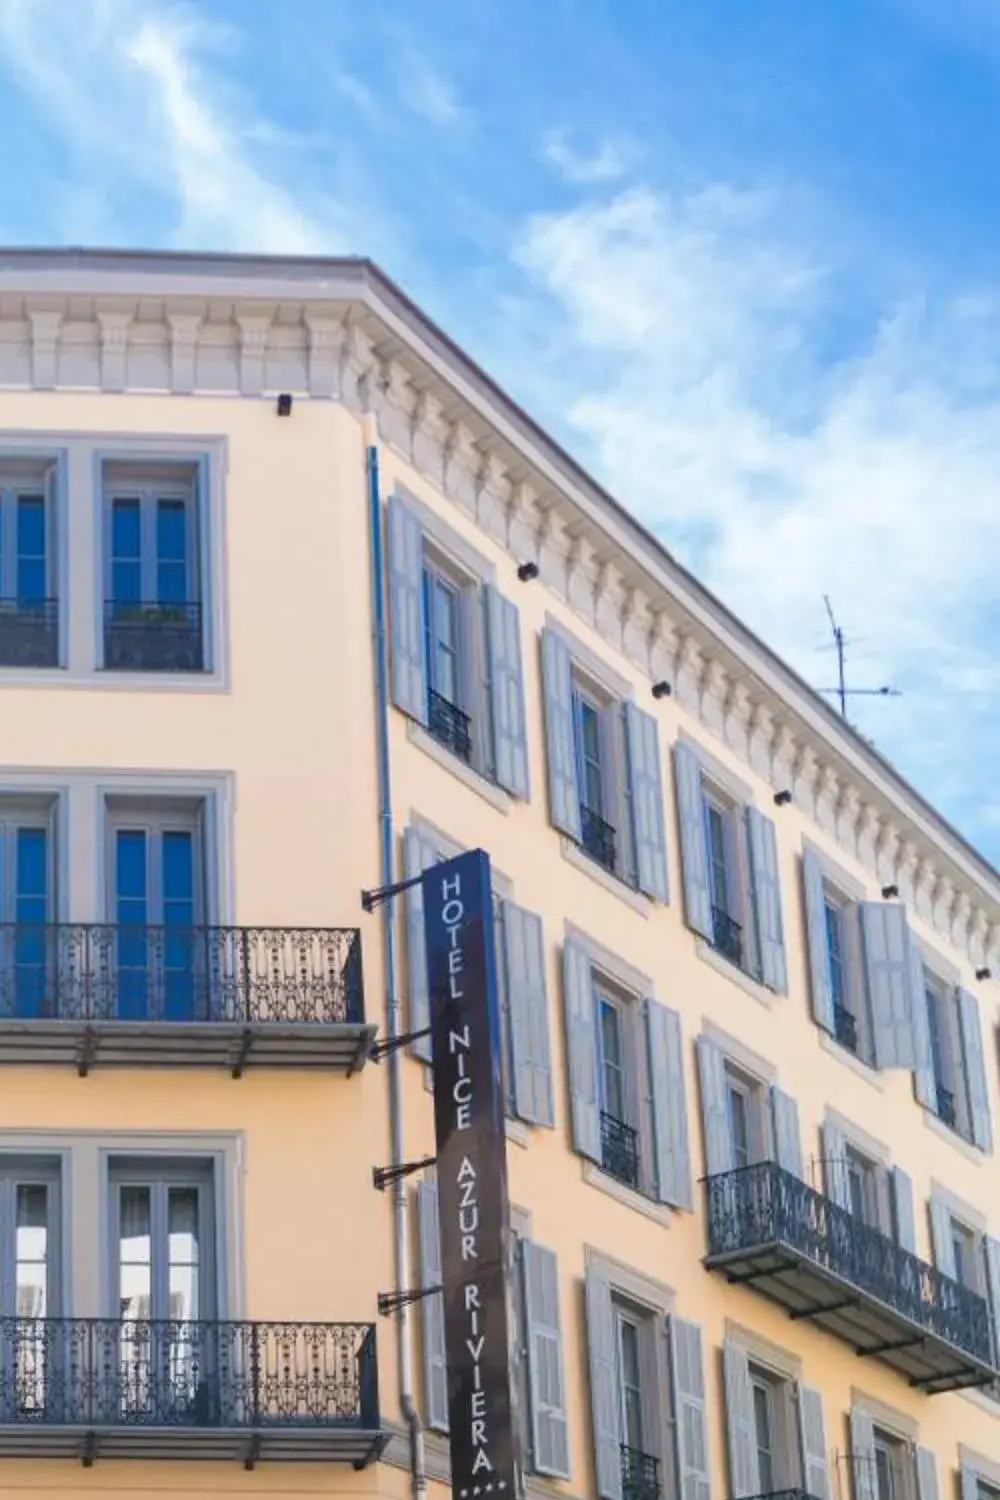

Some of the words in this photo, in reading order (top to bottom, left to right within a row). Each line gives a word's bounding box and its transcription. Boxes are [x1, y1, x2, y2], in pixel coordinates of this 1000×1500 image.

[442, 873, 464, 999] HOTEL
[449, 1025, 472, 1130] NICE
[457, 1156, 478, 1260] AZUR
[465, 1284, 493, 1475] RIVIERA
